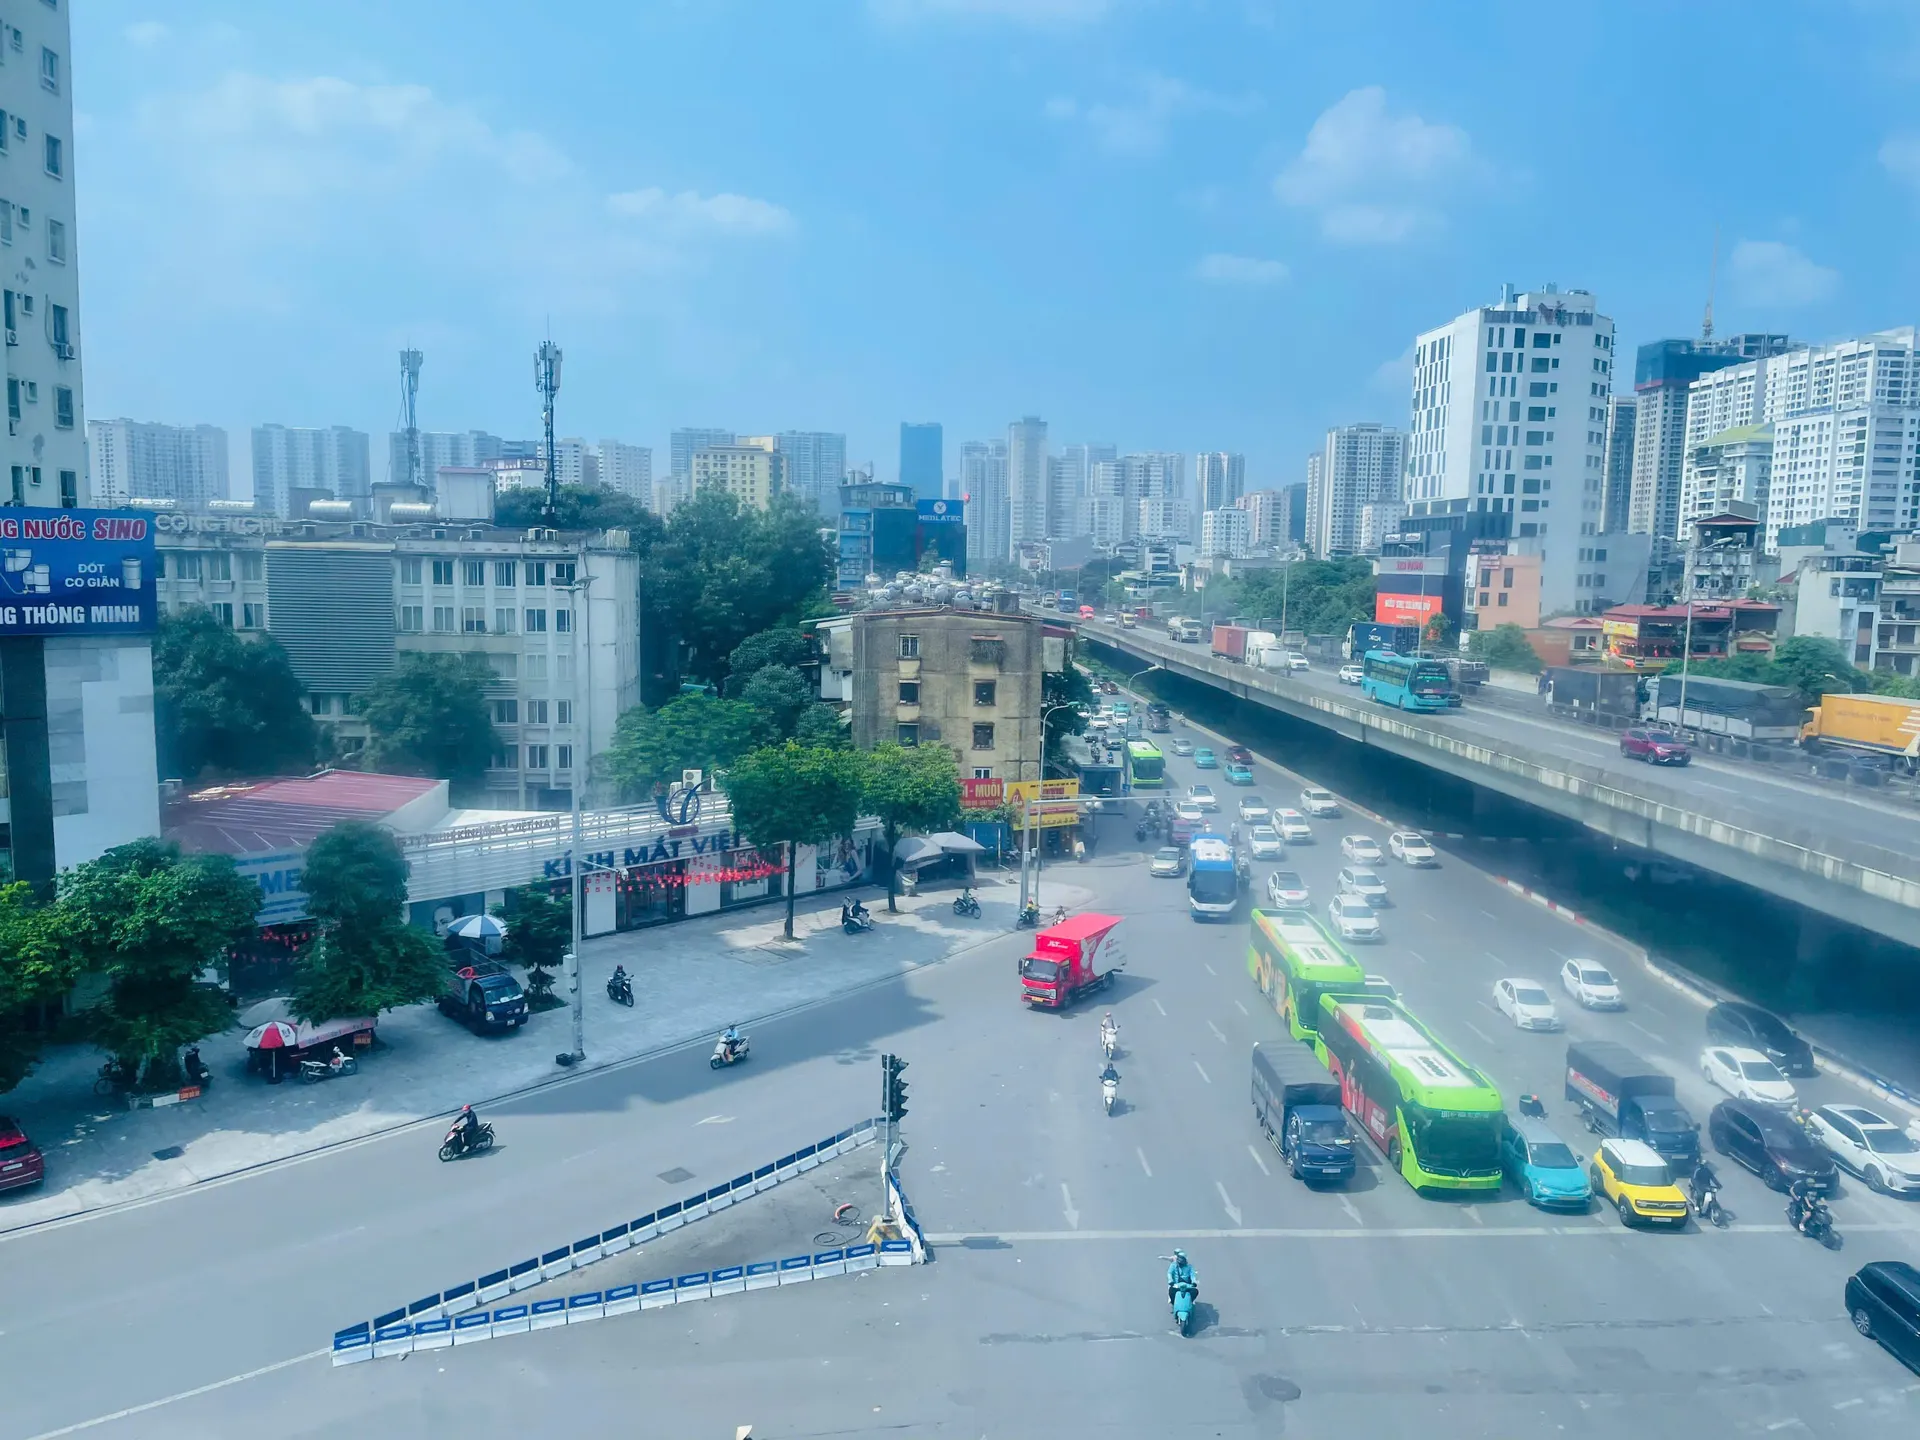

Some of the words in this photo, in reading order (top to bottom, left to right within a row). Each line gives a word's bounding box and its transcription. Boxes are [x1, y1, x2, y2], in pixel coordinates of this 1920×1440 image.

[23, 515, 86, 540] NƯỚC
[92, 518, 147, 541] SINO
[918, 514, 962, 522] MEDLATEC
[64, 577, 84, 588] CO
[87, 575, 120, 588] GIÃN
[22, 602, 85, 625] THÔNG
[91, 605, 140, 623] MINH
[544, 849, 614, 878] KÍNH
[624, 835, 683, 865] MẮT
